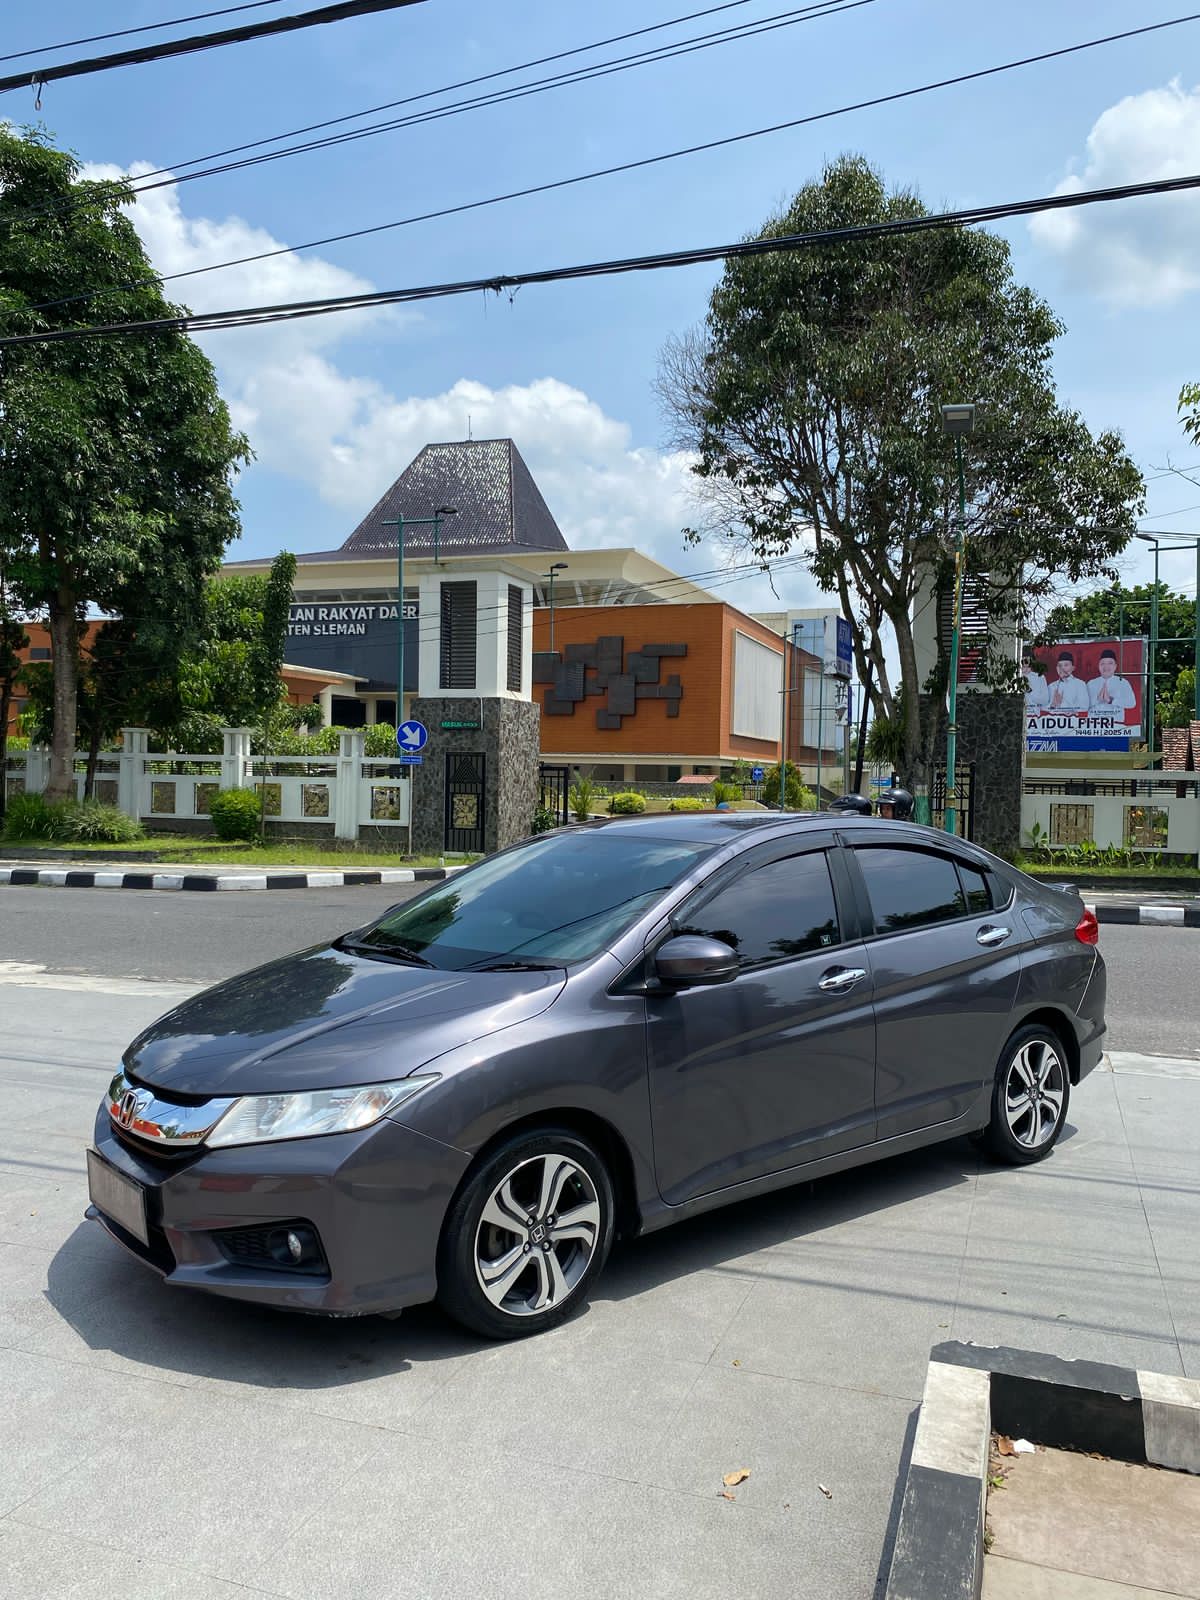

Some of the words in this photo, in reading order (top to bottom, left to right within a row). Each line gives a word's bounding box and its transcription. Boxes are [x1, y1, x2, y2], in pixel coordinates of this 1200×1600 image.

[318, 606, 375, 621] RAKYAT
[313, 623, 366, 636] SLEMAN
[1041, 718, 1074, 729] IDUL
[1078, 717, 1114, 729] FITRI
